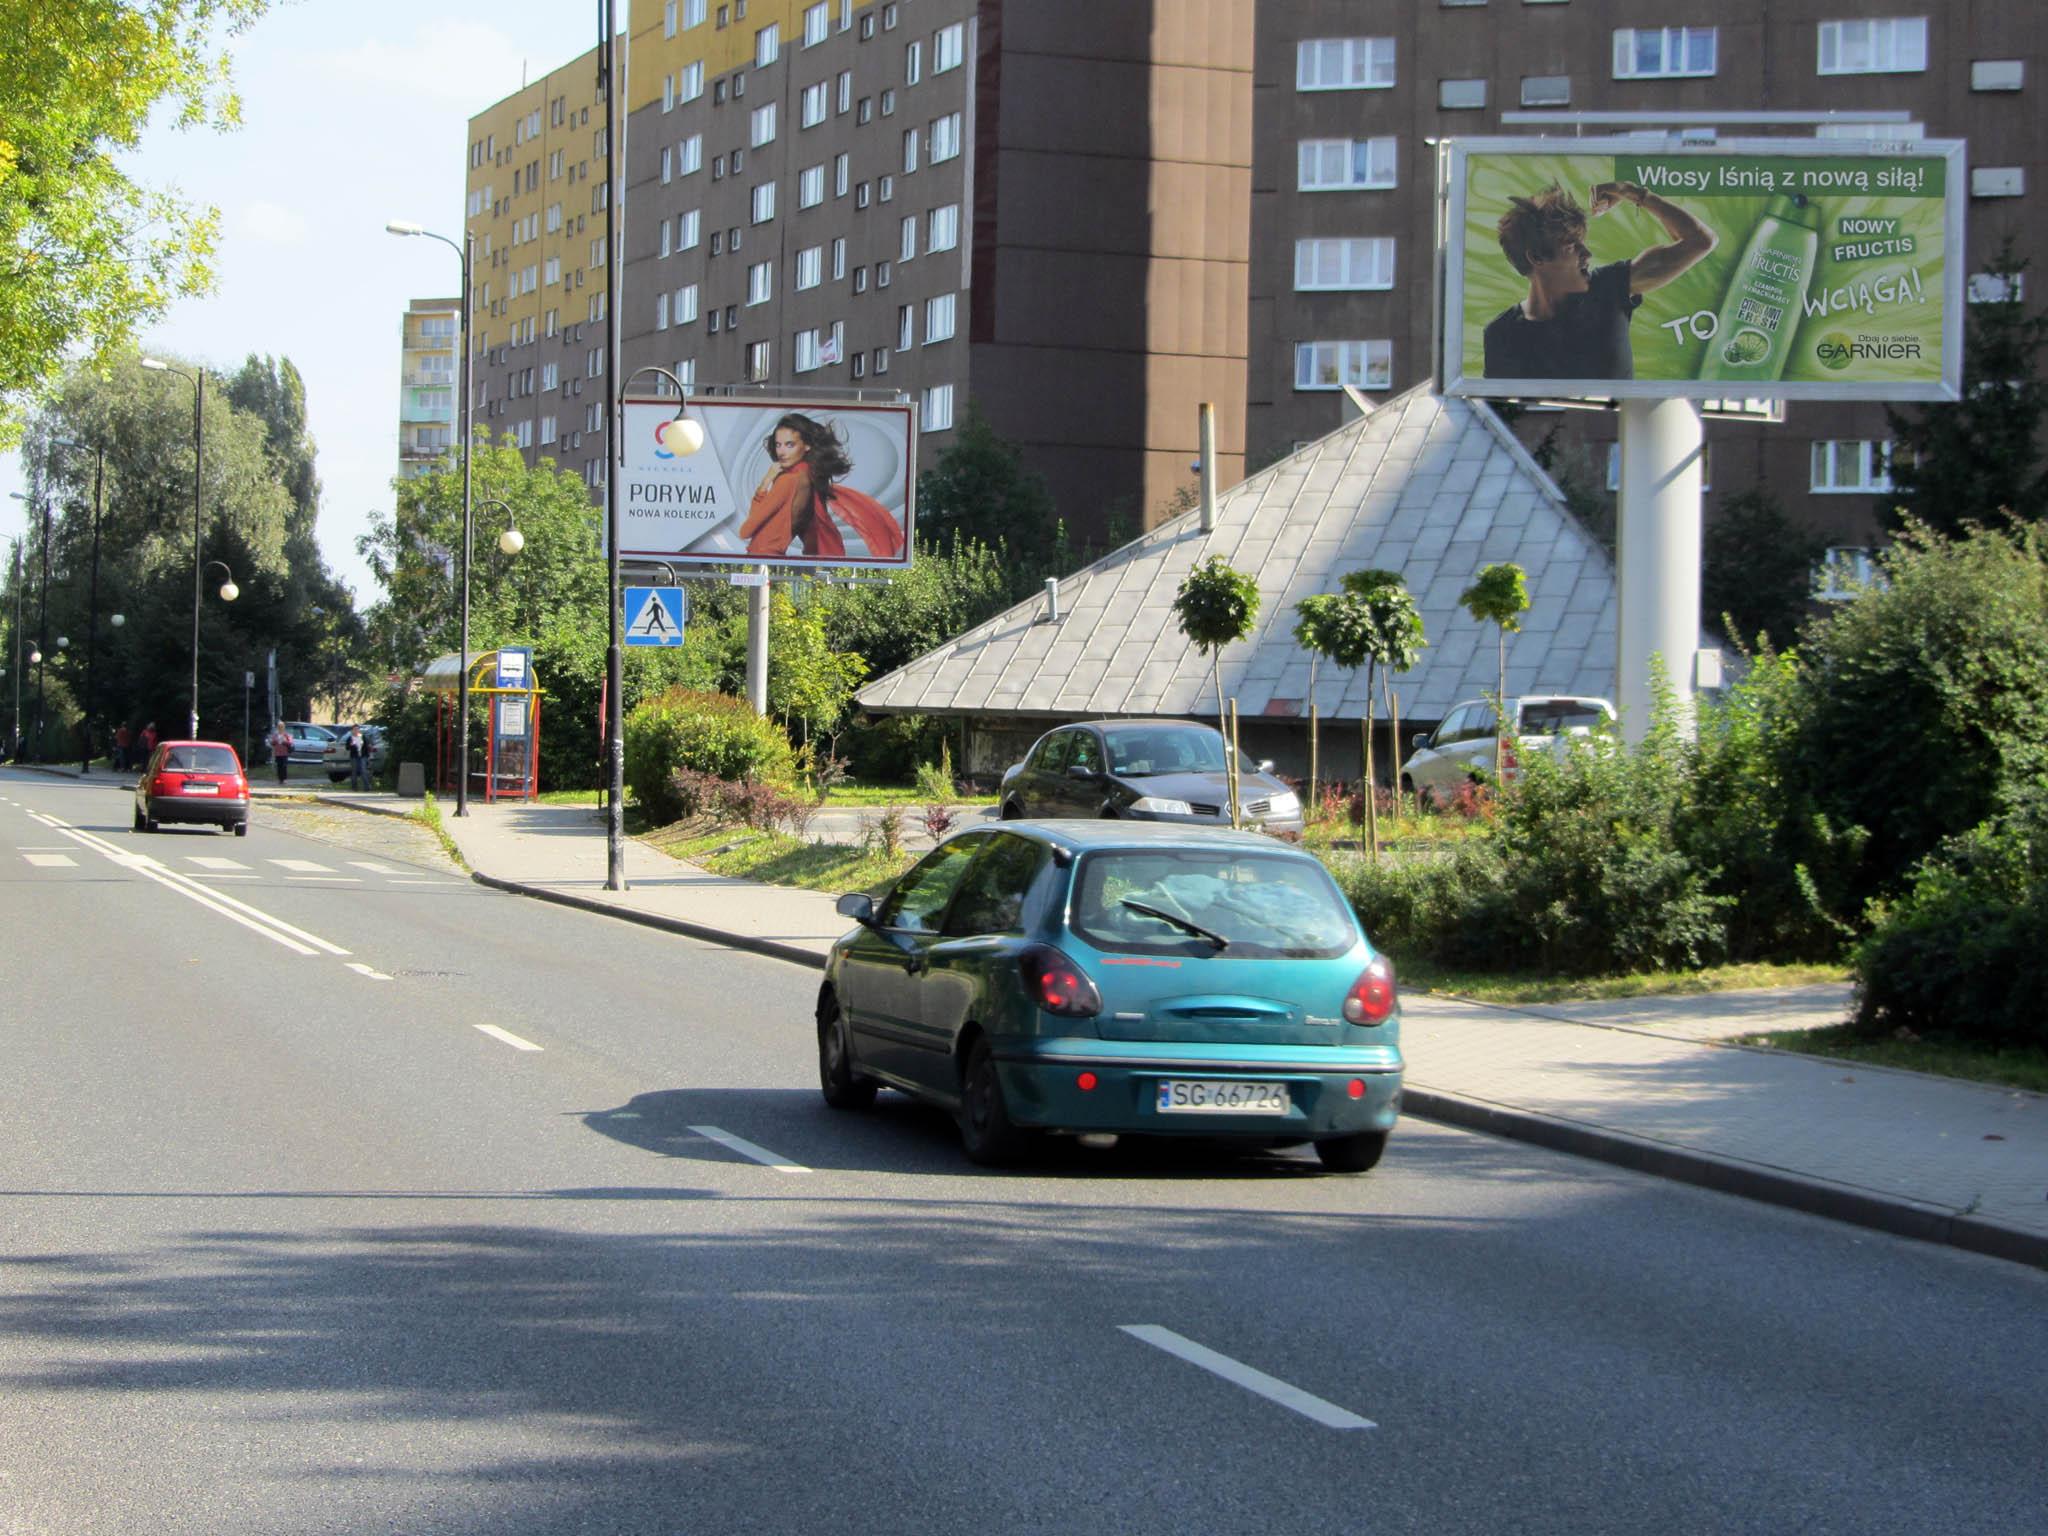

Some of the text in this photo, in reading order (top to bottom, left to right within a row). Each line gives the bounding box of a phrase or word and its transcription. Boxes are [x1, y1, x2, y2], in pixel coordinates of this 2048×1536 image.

[1636, 166, 1924, 192] Włosy lśnią z nową siłą!
[1842, 219, 1896, 234] NOWY
[1834, 238, 1913, 261] FRUCTIS
[1660, 266, 1926, 345] TO WCIĄGA!
[1858, 334, 1880, 344] Dbaj
[1816, 343, 1921, 359] GARNIER
[630, 483, 716, 505] PORYWA
[629, 508, 716, 520] NOWA KOLEKCJA
[1173, 1083, 1282, 1109] SG 66726
